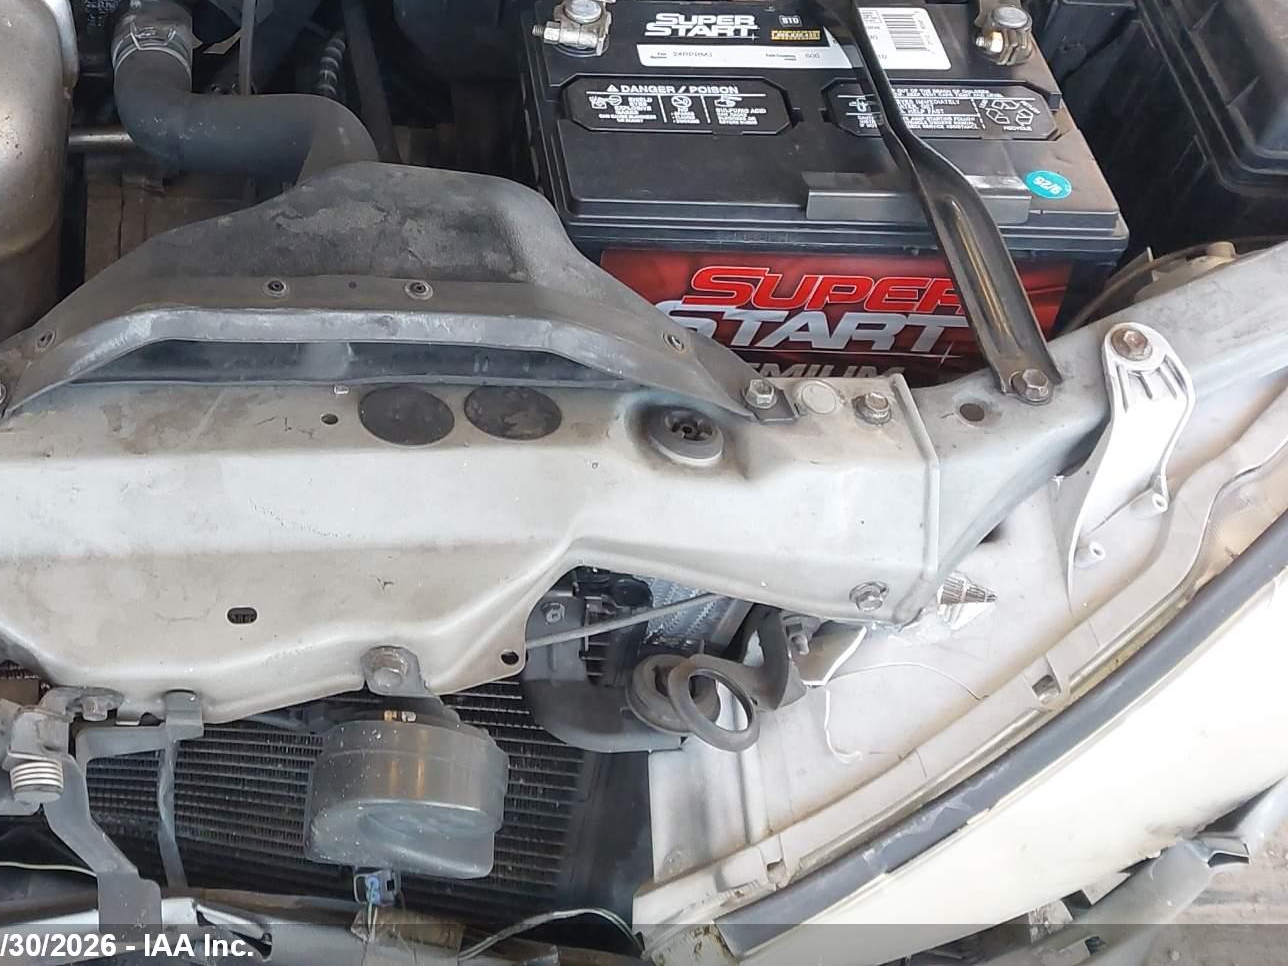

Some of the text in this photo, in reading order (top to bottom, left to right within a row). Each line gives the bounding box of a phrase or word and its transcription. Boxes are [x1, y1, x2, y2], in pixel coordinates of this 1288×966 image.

[655, 12, 755, 26] SUPER
[644, 22, 758, 37] START
[620, 84, 676, 94] DANGER
[688, 85, 739, 95] POISON
[656, 300, 969, 353] START
